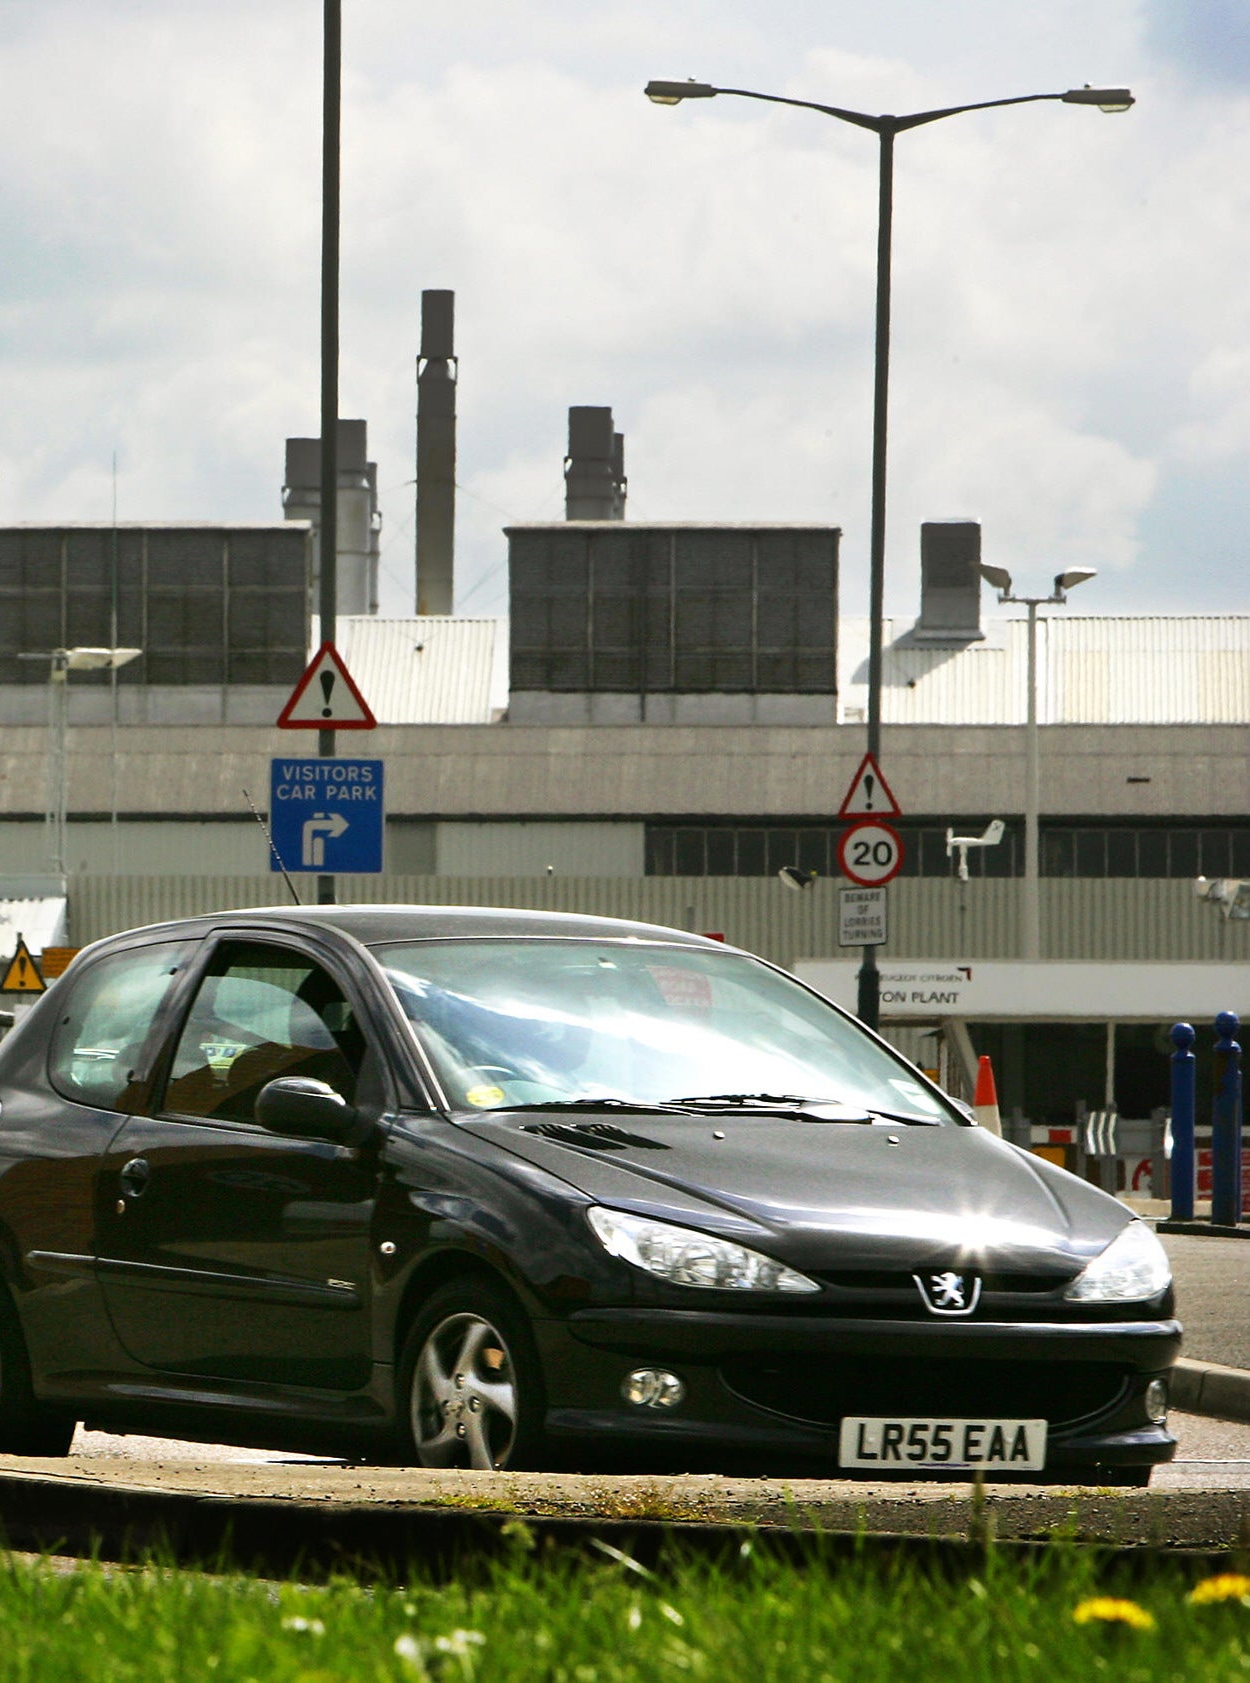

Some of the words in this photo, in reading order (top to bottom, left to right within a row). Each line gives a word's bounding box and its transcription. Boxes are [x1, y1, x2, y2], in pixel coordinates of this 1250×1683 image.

[282, 766, 373, 782] VISITORS
[277, 784, 316, 800] CAR
[326, 785, 377, 800] PARK
[853, 841, 893, 866] 20
[857, 904, 869, 915] OF
[843, 929, 884, 940] TURNING
[911, 992, 959, 1004] PLANT
[856, 1422, 954, 1462] LR55
[962, 1424, 1030, 1462] EAA
